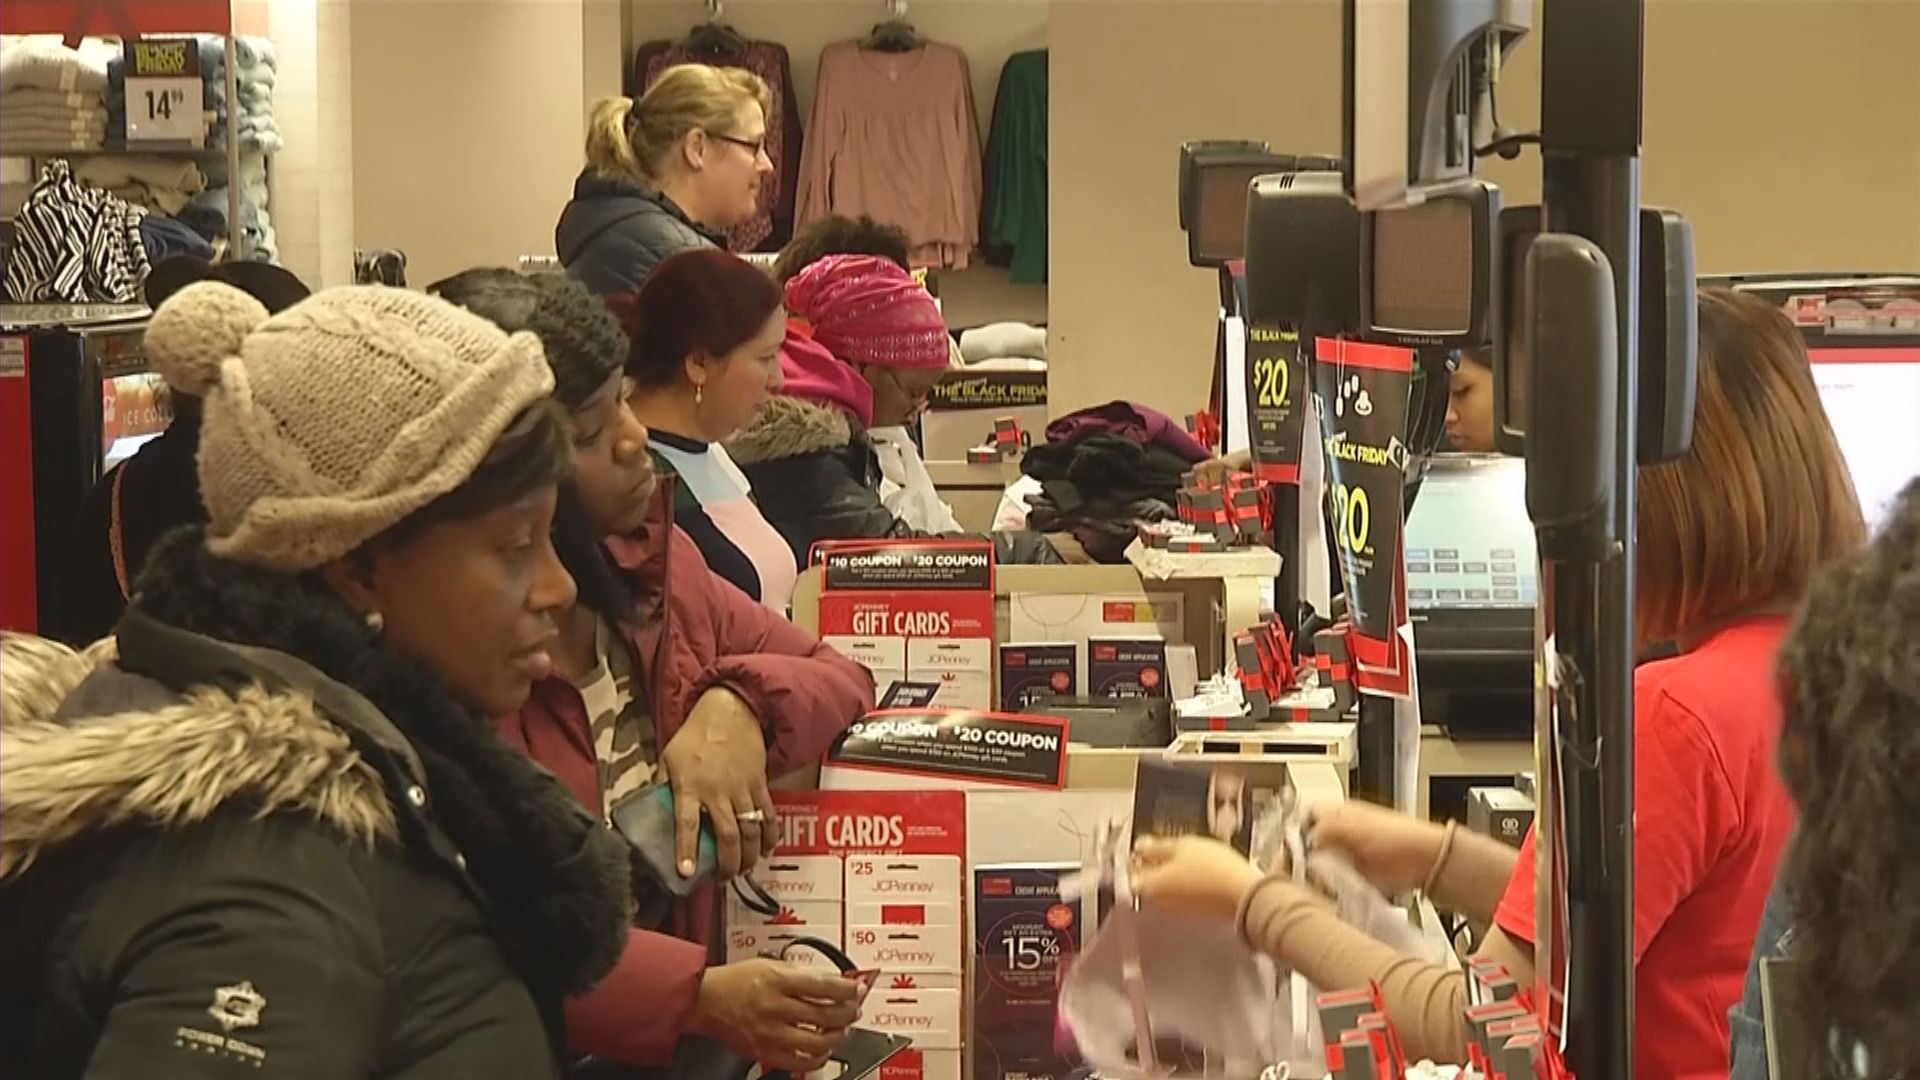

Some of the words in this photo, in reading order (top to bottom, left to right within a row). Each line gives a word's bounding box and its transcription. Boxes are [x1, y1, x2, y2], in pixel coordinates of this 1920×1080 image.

[933, 384, 958, 397] THE
[962, 383, 1006, 396] BLACK
[1009, 383, 1047, 396] FRIDA
[1254, 357, 1289, 407] $20
[1357, 446, 1389, 465] FRIDAY
[830, 555, 848, 569] $10
[850, 555, 902, 568] COUPON
[913, 555, 934, 567] $20
[935, 554, 988, 567] COUPON
[852, 611, 890, 635] GIFT
[893, 611, 950, 635] CARDS
[927, 654, 972, 666] JCPenney
[866, 721, 939, 740] COUPON
[954, 726, 982, 742] $20
[984, 729, 1060, 751] COUPON
[825, 815, 904, 847] CARDS
[851, 862, 873, 876] $25
[762, 880, 815, 895] CPenney
[872, 880, 934, 895] JCPenney
[851, 932, 876, 945] $50
[873, 948, 936, 964] JCPenney
[1002, 937, 1060, 970] 15%
[870, 1012, 934, 1028] JCPenney
